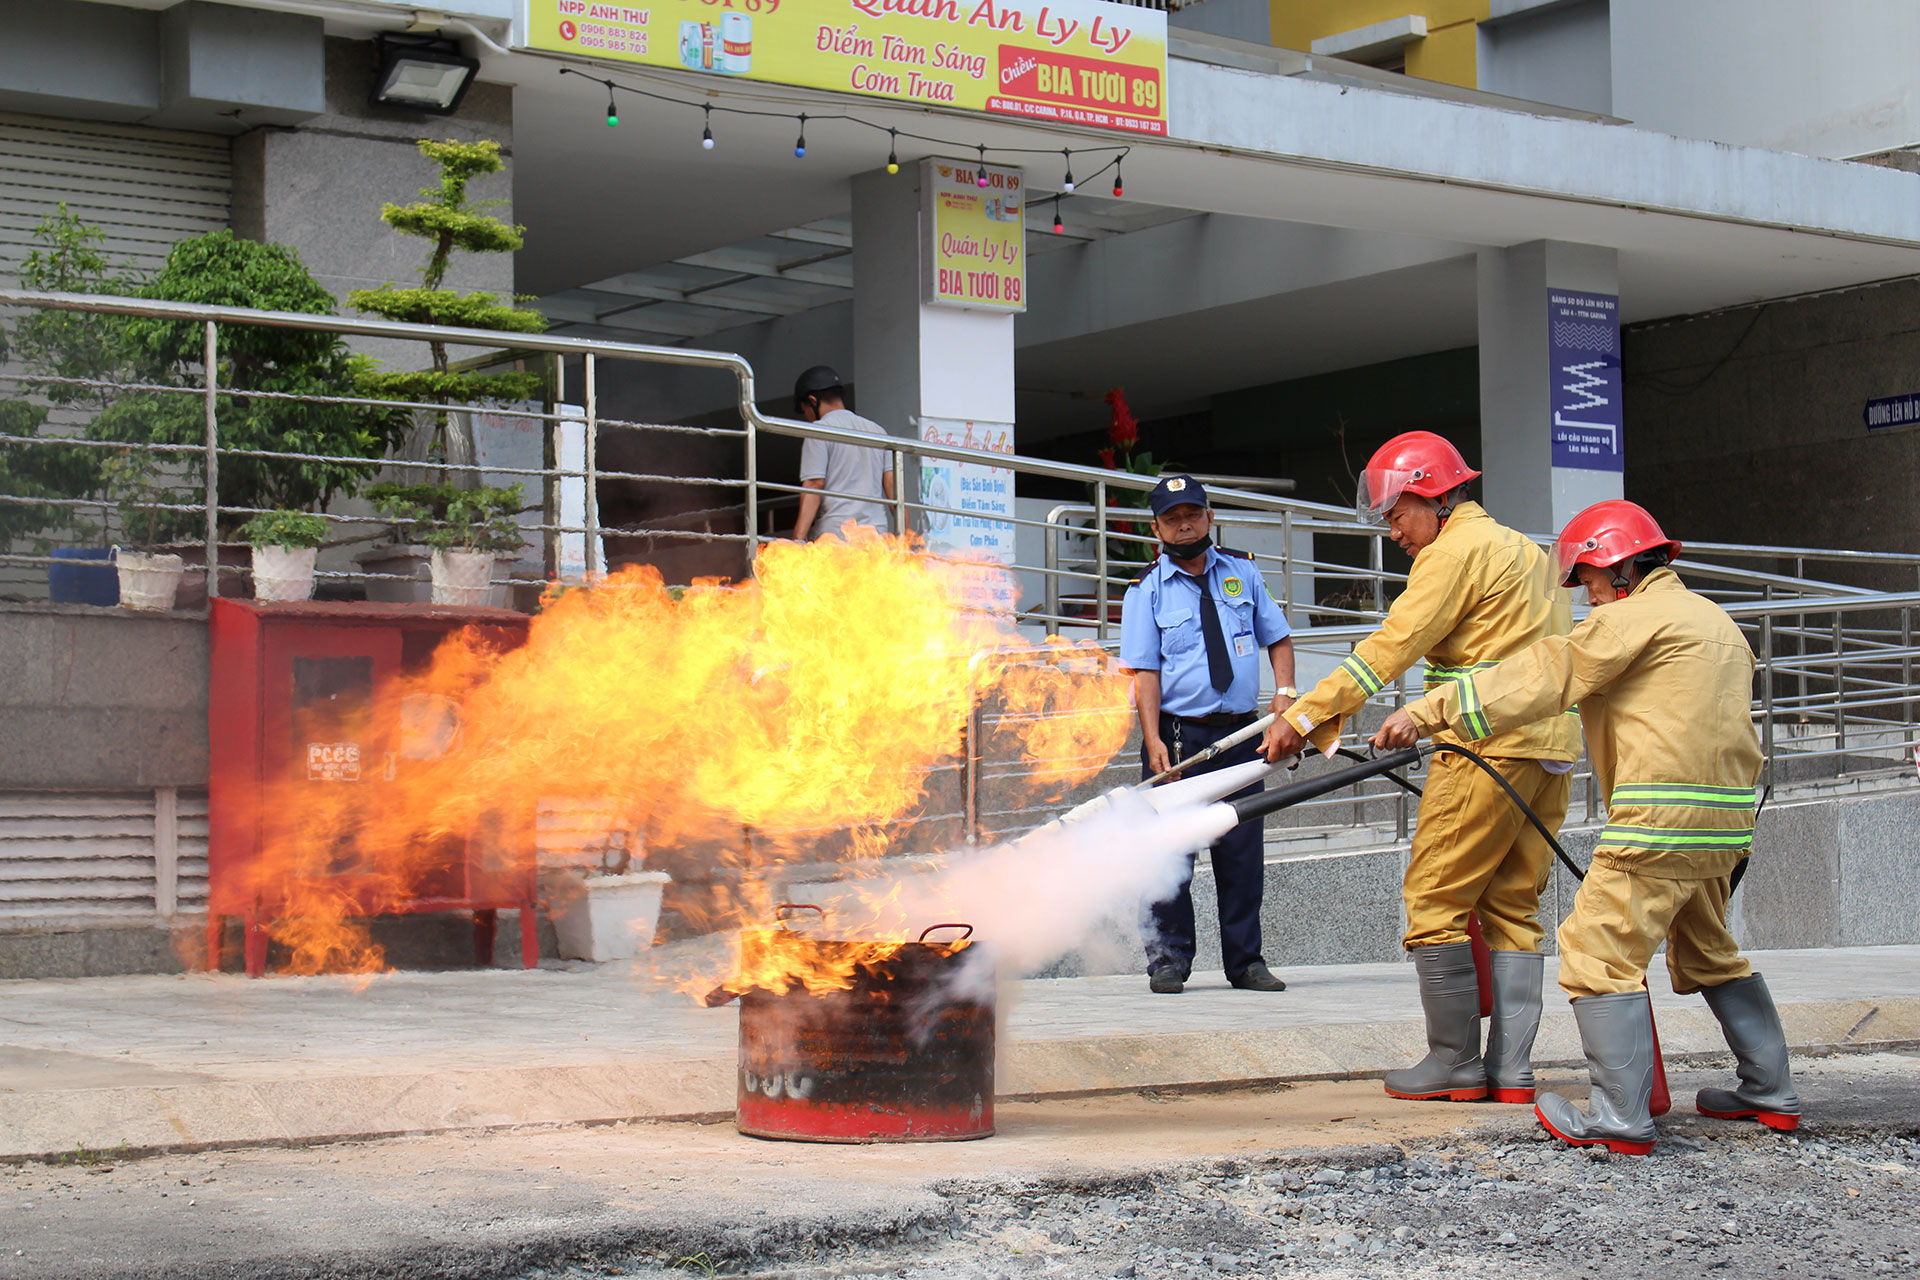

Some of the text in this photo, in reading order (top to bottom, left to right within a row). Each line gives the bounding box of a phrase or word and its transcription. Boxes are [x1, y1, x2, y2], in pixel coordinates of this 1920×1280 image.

[560, 0, 649, 24] NPP ANH THƯ
[580, 24, 647, 41] 0906 883 824
[580, 36, 647, 54] 0905 985 703
[1037, 7, 1078, 45] Ly
[1091, 16, 1131, 53] Ly
[816, 25, 987, 79] Điểm Tâm Sáng
[851, 65, 954, 101] Cơm Trưa
[1001, 56, 1157, 108] Chiều: BIA TƯƠI 89
[955, 168, 975, 185] BIA
[1006, 176, 1020, 190] 89
[941, 232, 1018, 265] Quán Ly Ly
[939, 268, 1021, 302] BIA TƯƠI 89
[1891, 400, 1903, 422] LÊN
[1903, 395, 1914, 420] HỒ
